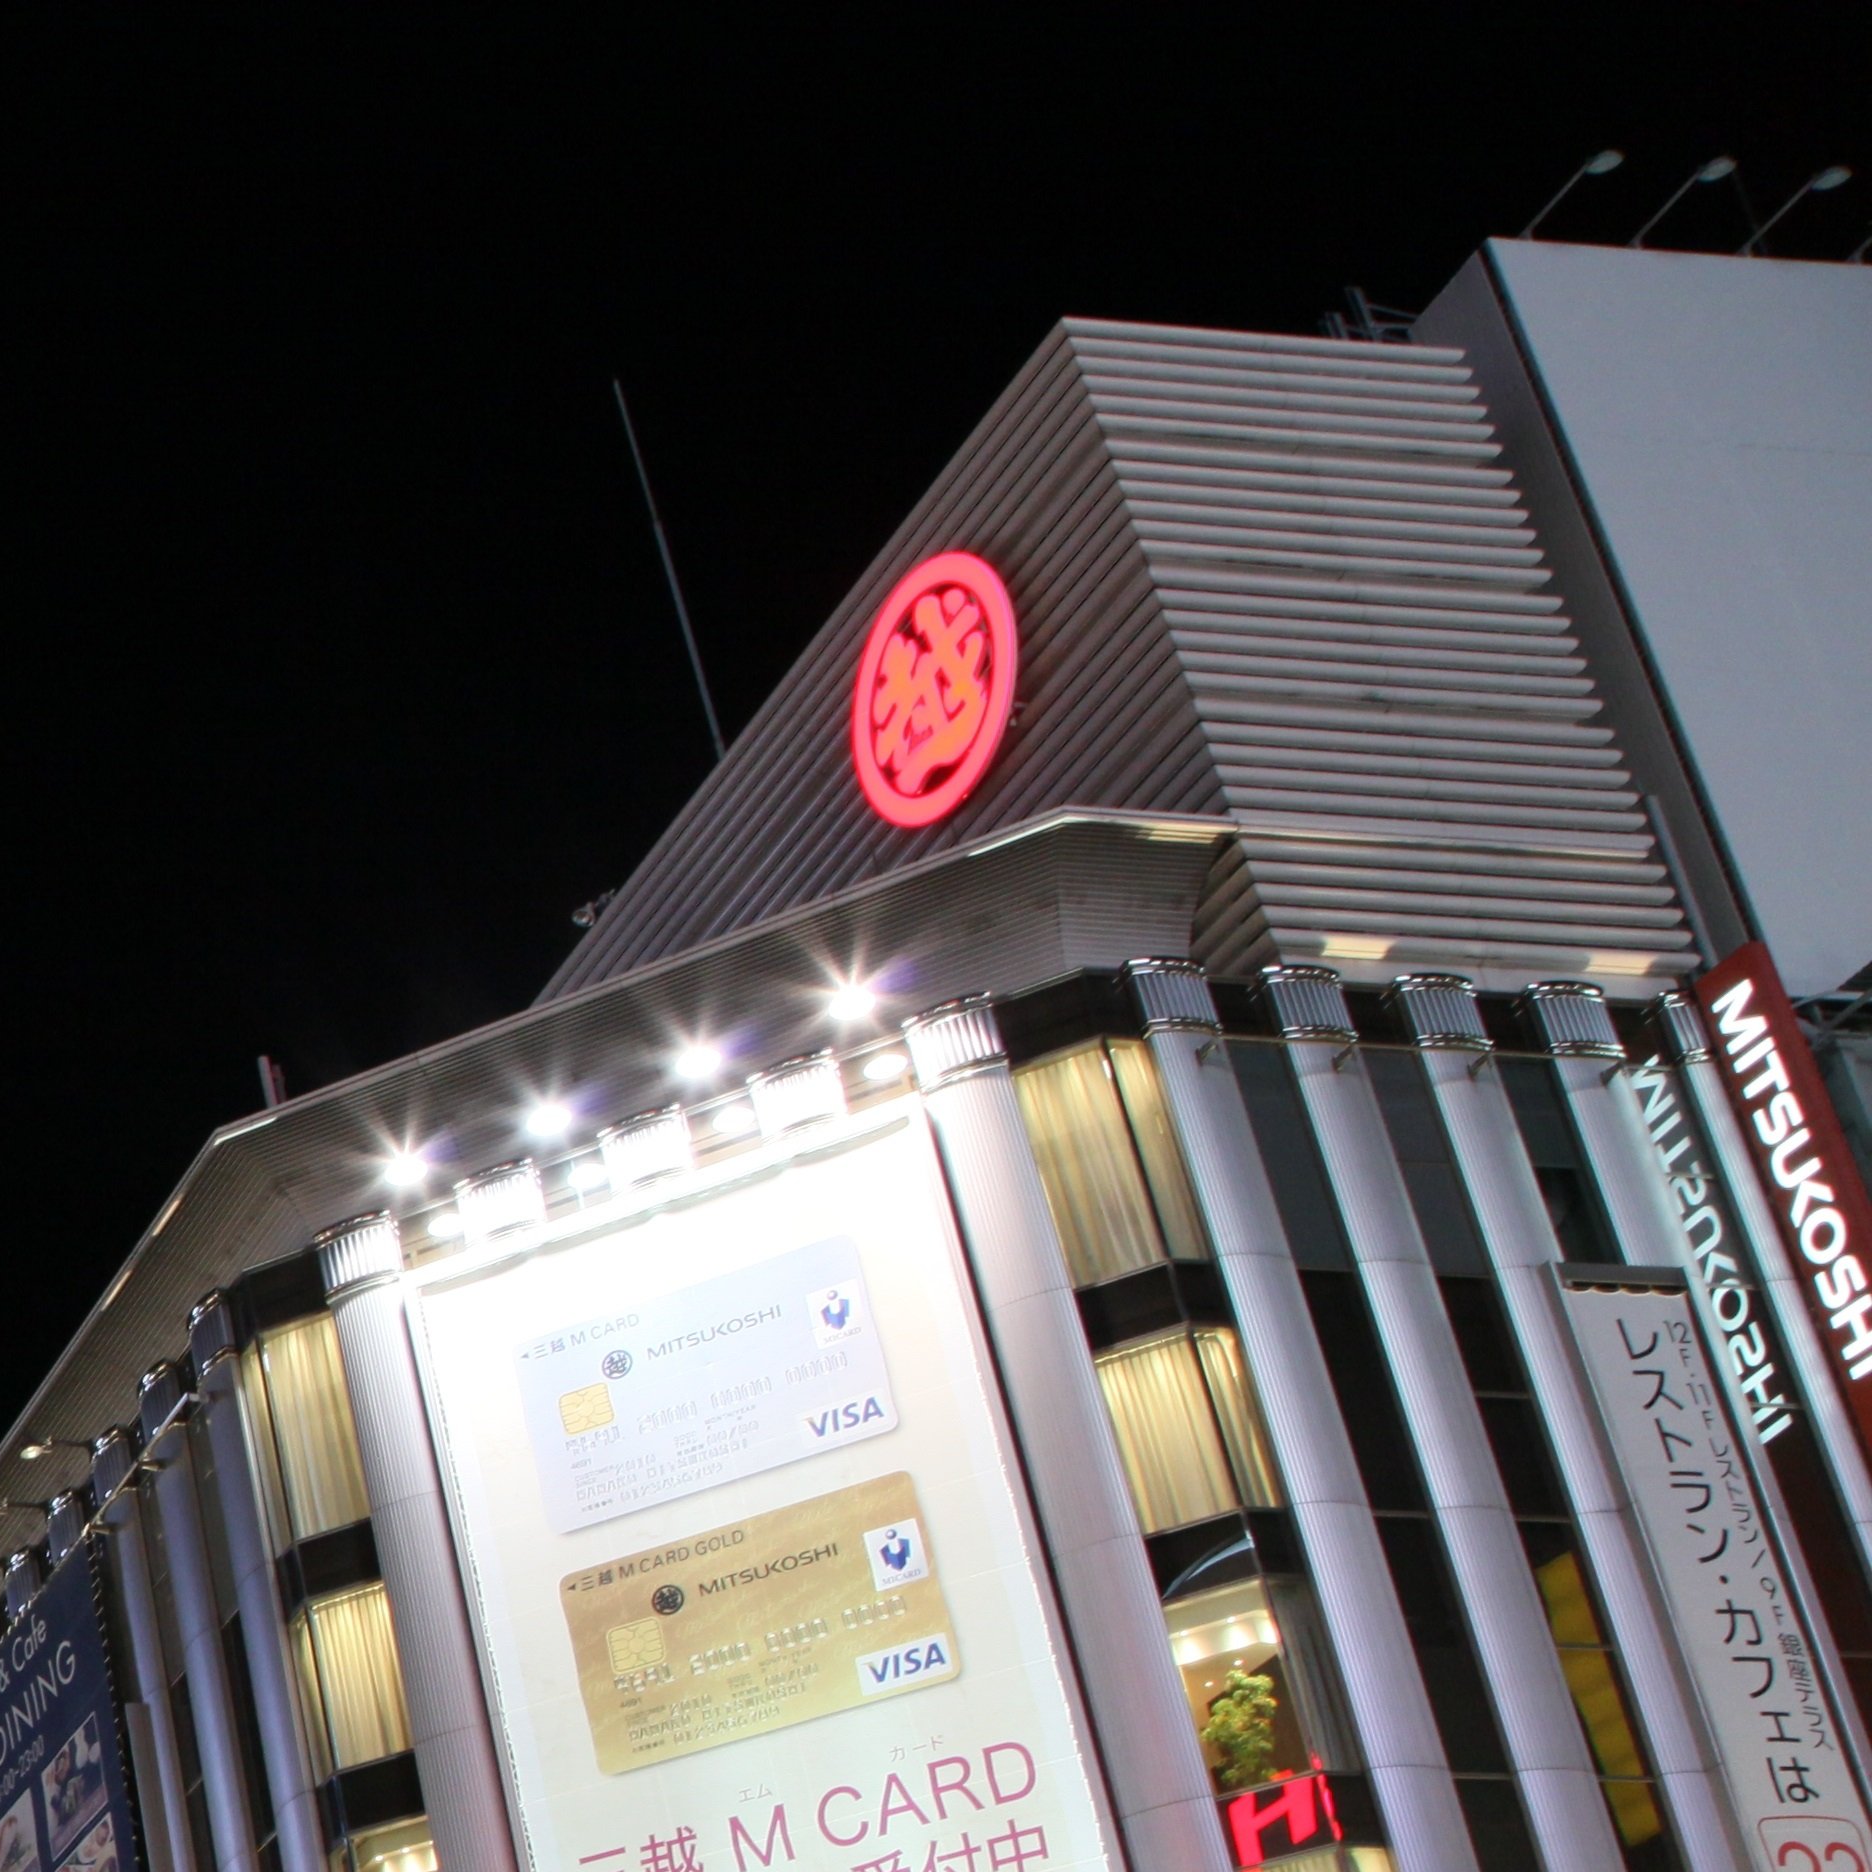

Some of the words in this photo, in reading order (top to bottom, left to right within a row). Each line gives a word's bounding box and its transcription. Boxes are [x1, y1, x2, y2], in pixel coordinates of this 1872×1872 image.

[646, 1303, 783, 1362] MITSUKOSHI
[805, 1396, 885, 1439] VISA
[579, 1569, 614, 1592] 三越
[618, 1559, 636, 1580] M
[639, 1543, 691, 1573] CARD
[694, 1528, 746, 1557] GOLD
[698, 1542, 838, 1597] MITSUKOSHI
[11, 1620, 47, 1672] Cafe
[867, 1640, 947, 1684] VISA
[888, 1733, 945, 1762] カード
[815, 1740, 1039, 1848] CARD
